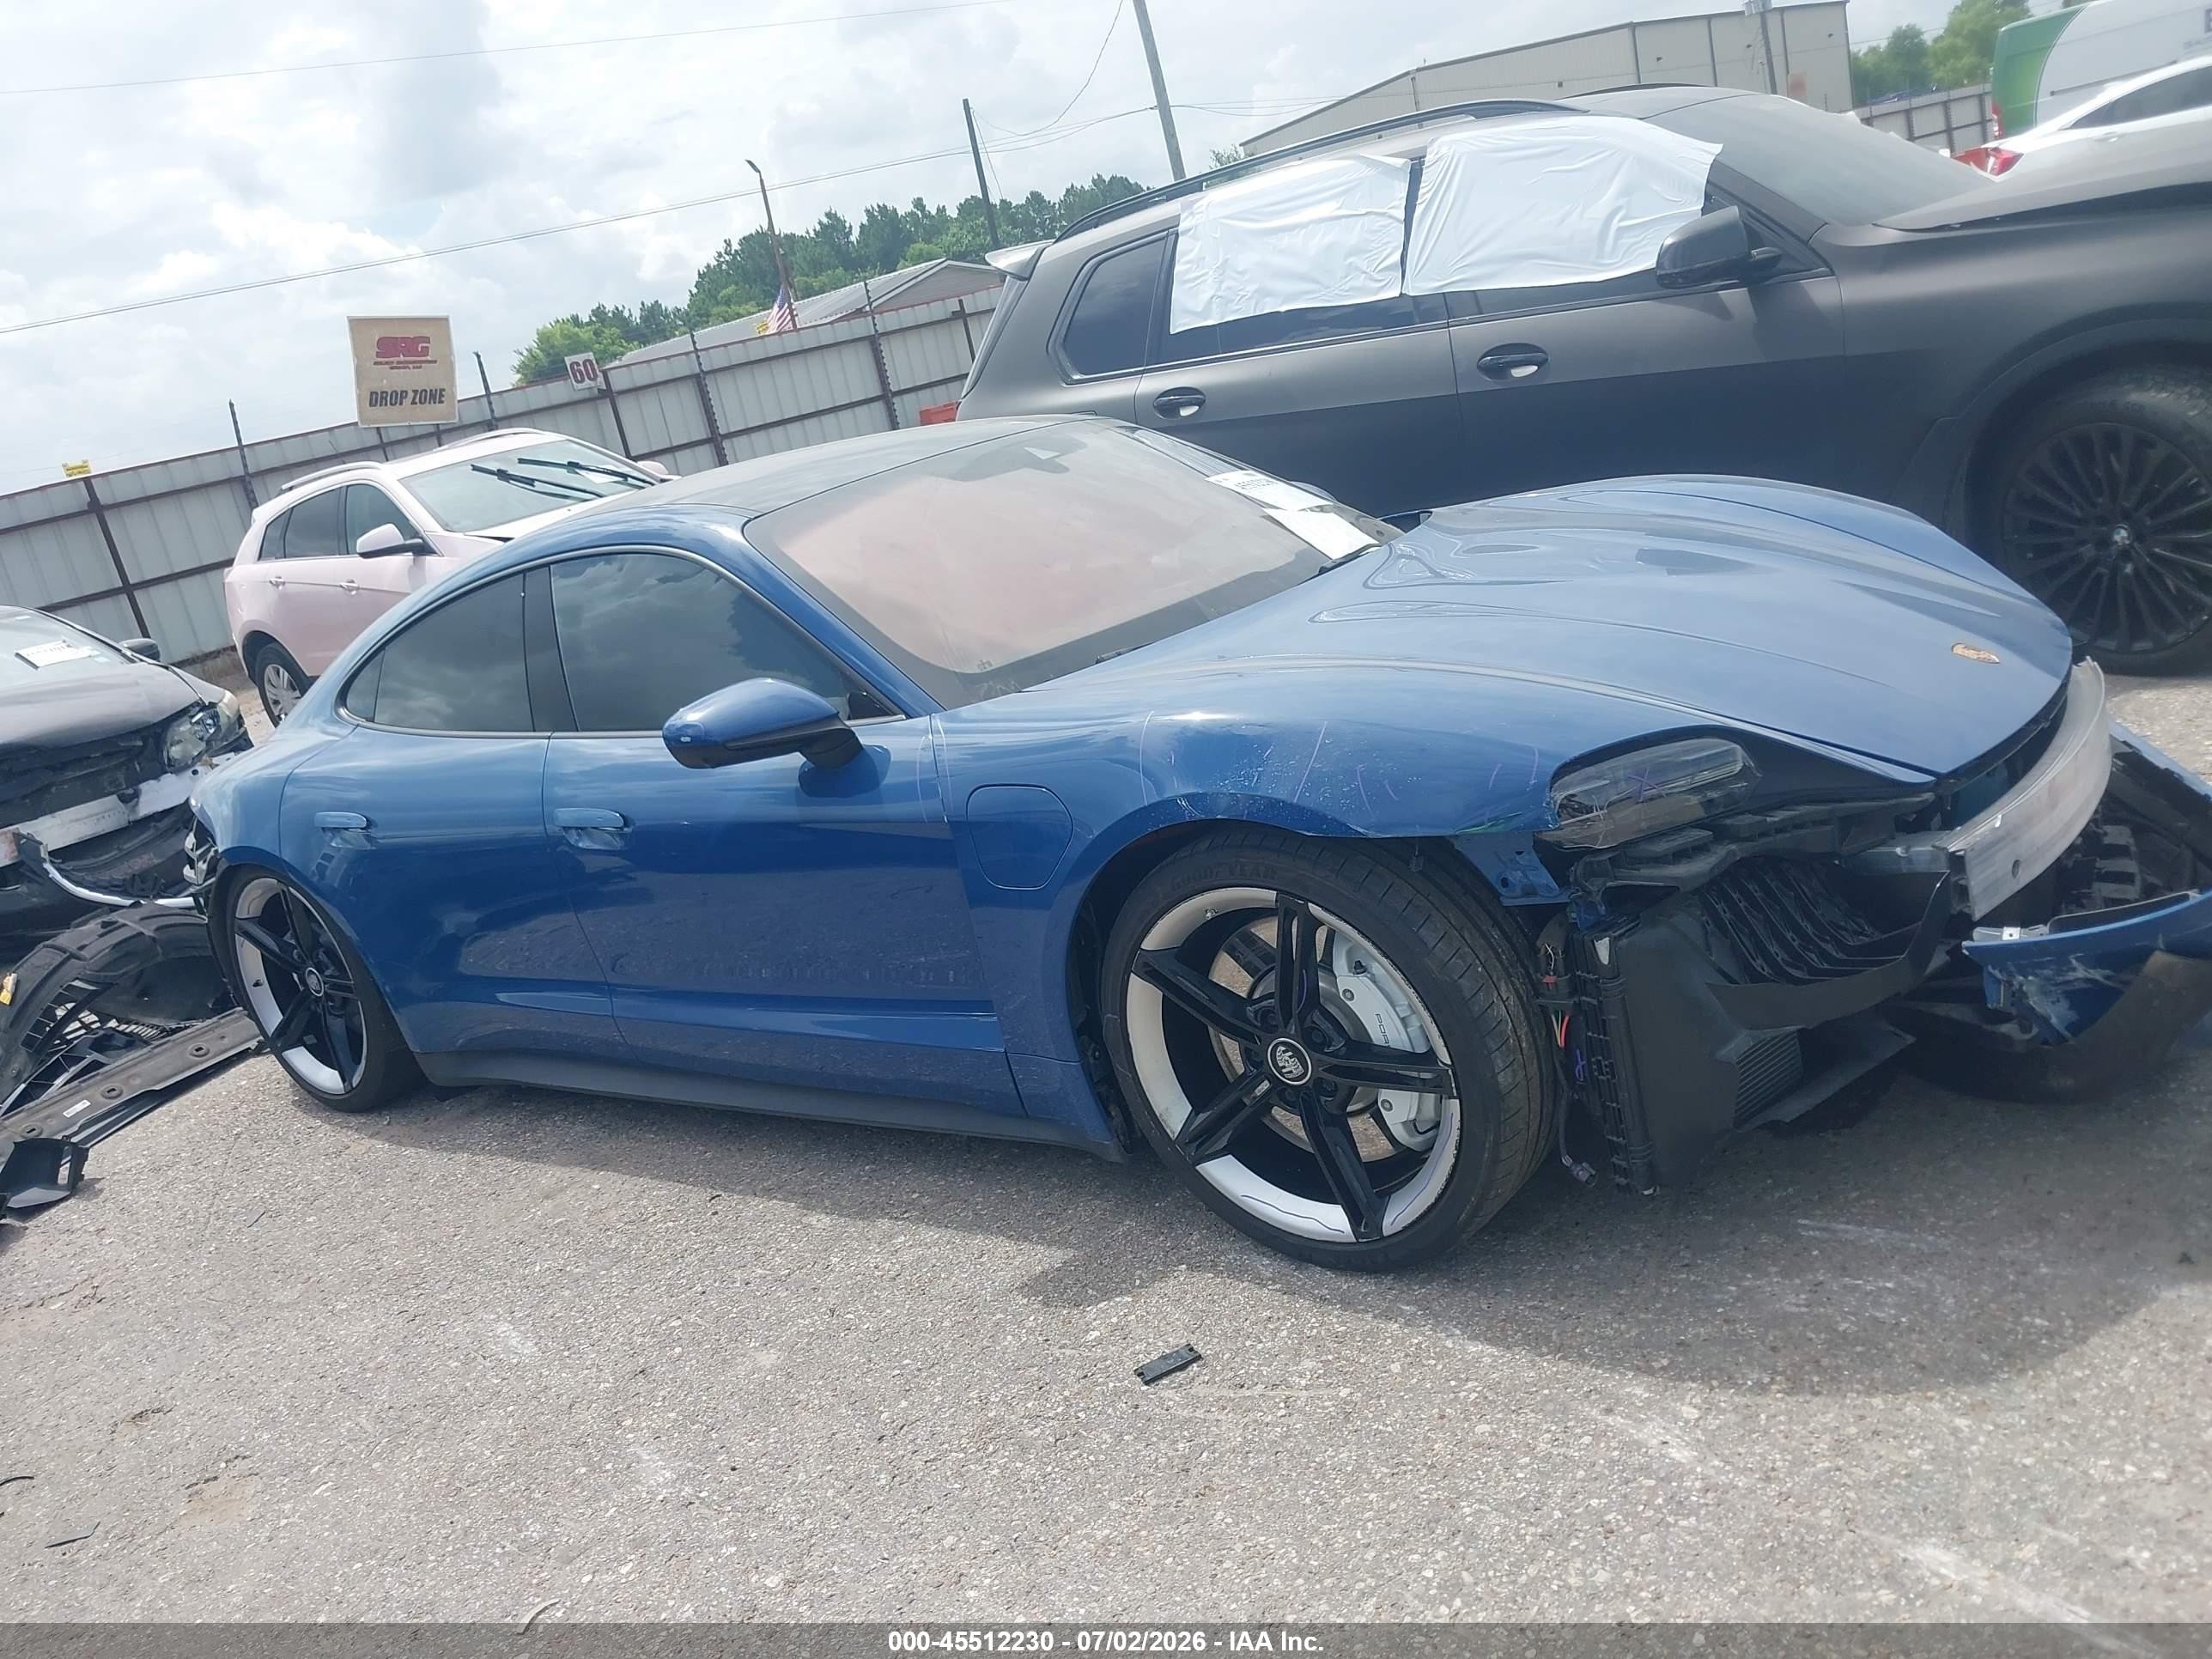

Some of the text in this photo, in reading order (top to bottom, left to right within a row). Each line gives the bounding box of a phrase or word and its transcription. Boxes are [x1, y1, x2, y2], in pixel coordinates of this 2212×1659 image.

[569, 358, 599, 384] 60
[369, 388, 446, 407] DROP ZONE
[1374, 1013, 1390, 1045] POR
